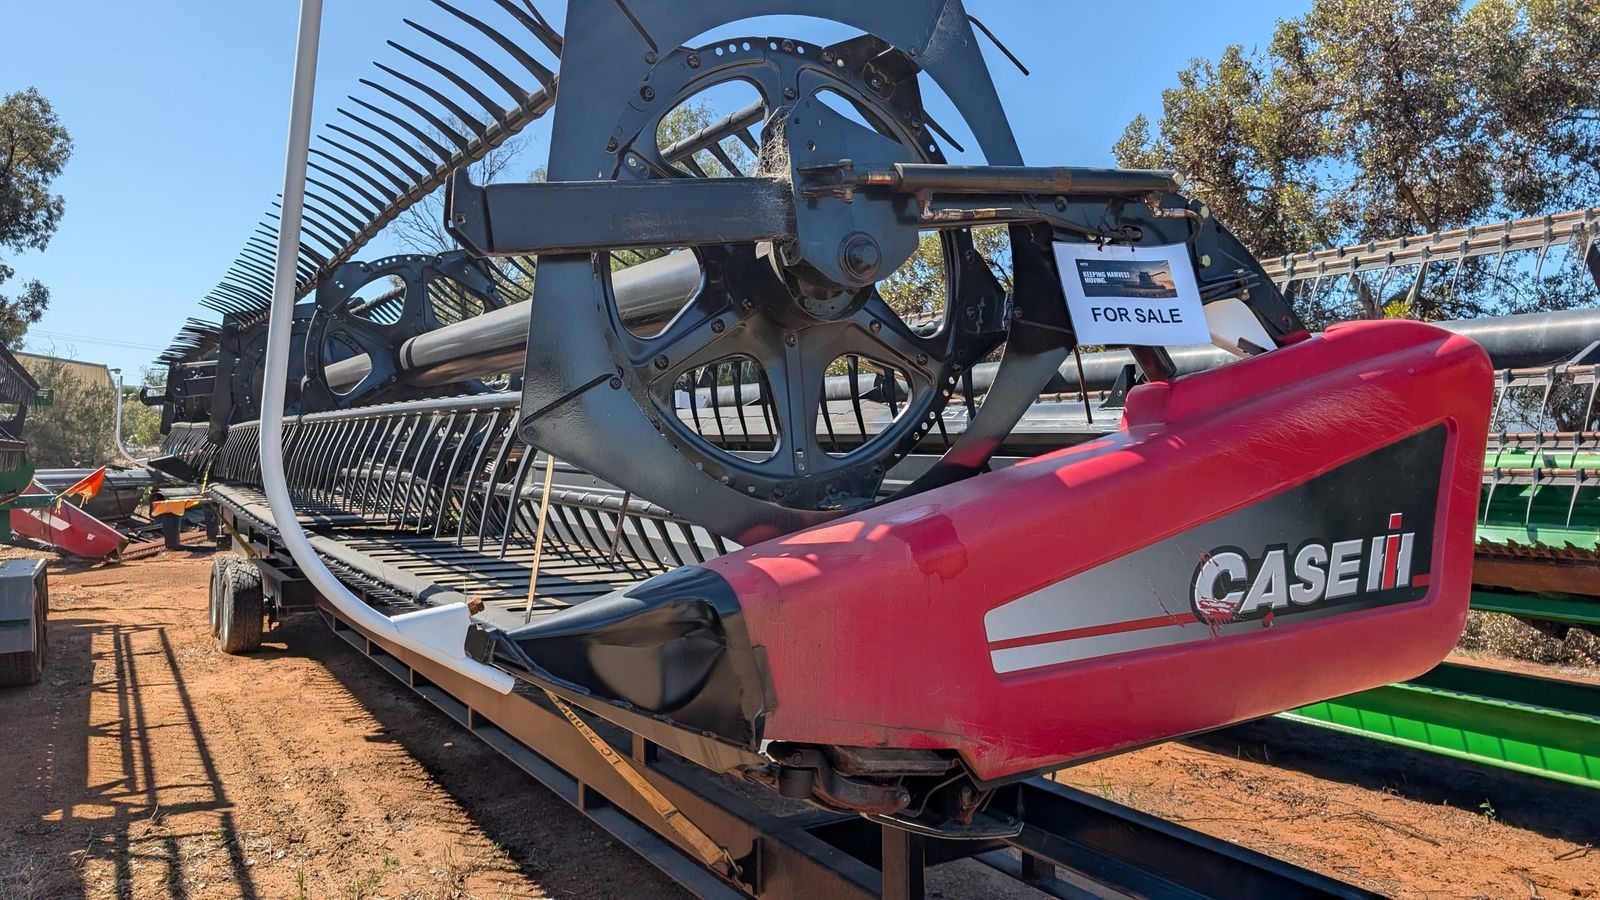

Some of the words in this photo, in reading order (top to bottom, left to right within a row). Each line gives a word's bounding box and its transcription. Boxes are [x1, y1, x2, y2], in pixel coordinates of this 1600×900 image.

[1106, 271, 1130, 279] HARVEST
[1091, 306, 1131, 322] FOR
[1134, 307, 1183, 323] SALE
[1194, 538, 1363, 615] CASE
